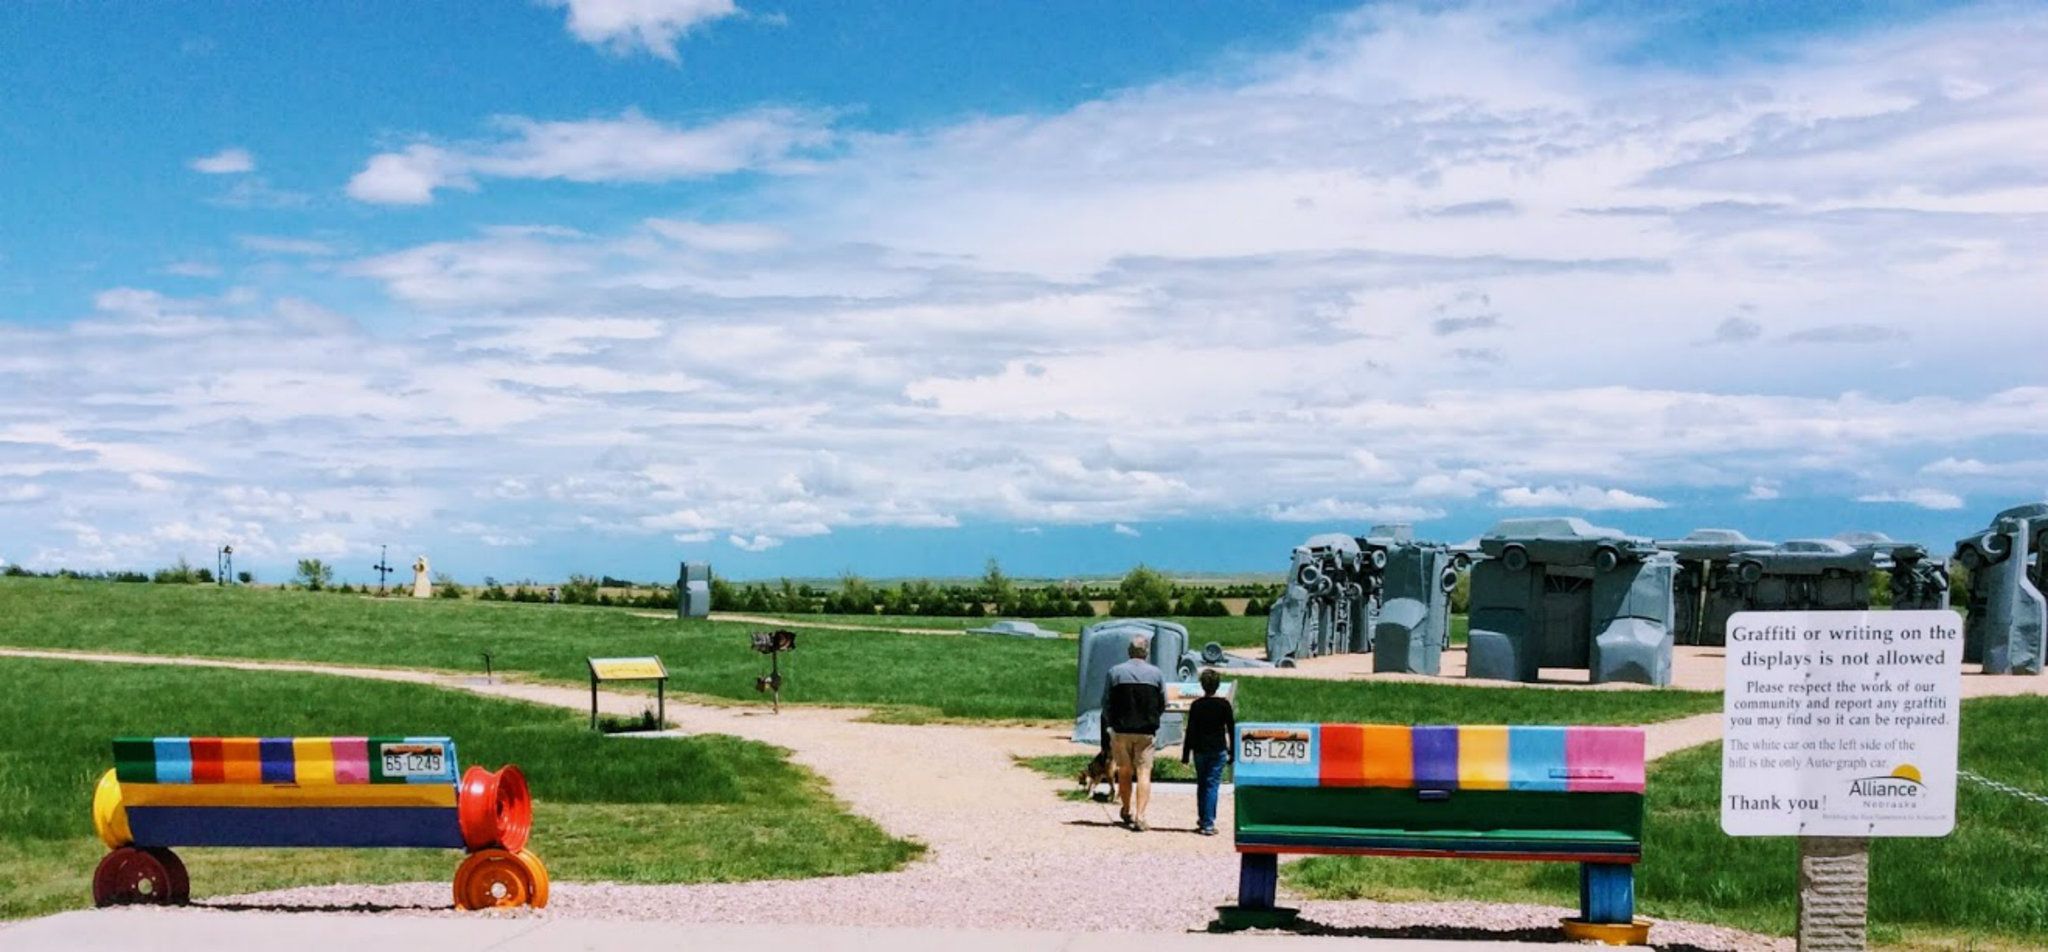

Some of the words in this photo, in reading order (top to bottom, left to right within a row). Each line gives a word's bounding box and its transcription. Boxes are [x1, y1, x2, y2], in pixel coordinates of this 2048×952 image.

[1731, 625, 1797, 642] Graffiti
[1803, 628, 1822, 642] or
[1829, 626, 1894, 644] writing
[1899, 627, 1922, 640] on
[1929, 625, 1957, 641] the
[1740, 651, 1812, 670] displays
[1819, 650, 1834, 666] is
[1840, 652, 1870, 666] not
[1876, 649, 1946, 666] allowed
[1746, 680, 1785, 693] Please
[1787, 681, 1833, 697] respect
[1836, 680, 1857, 693] the
[1860, 680, 1893, 693] work
[1896, 680, 1910, 693] of
[1914, 682, 1936, 693] our
[1733, 697, 1802, 713] community
[1806, 697, 1830, 710] and
[1834, 698, 1873, 713] report
[1876, 699, 1899, 712] any
[1903, 696, 1948, 713] graffiti
[1730, 716, 1753, 730] you
[1757, 715, 1782, 729] may
[1786, 713, 1812, 726] find
[1816, 715, 1831, 726] so
[1835, 713, 1845, 726] it
[1848, 715, 1871, 726] can
[1874, 713, 1891, 726] be
[1894, 713, 1950, 729] repaired.
[1728, 739, 1750, 751] The
[1751, 739, 1782, 751] white
[1783, 740, 1800, 751] car
[1803, 740, 1817, 751] on
[1819, 738, 1837, 751] the
[1839, 738, 1857, 751] left
[1859, 739, 1881, 751] side
[1884, 738, 1898, 751] of
[1898, 739, 1916, 751] the
[1728, 756, 1747, 769] hill
[1749, 756, 1758, 769] is
[1760, 756, 1777, 769] the
[1778, 756, 1802, 771] only
[1805, 756, 1867, 772] Auto-graph
[1848, 780, 1918, 797] Alliance
[1727, 794, 1782, 811] Thank
[1787, 794, 1828, 816] you!
